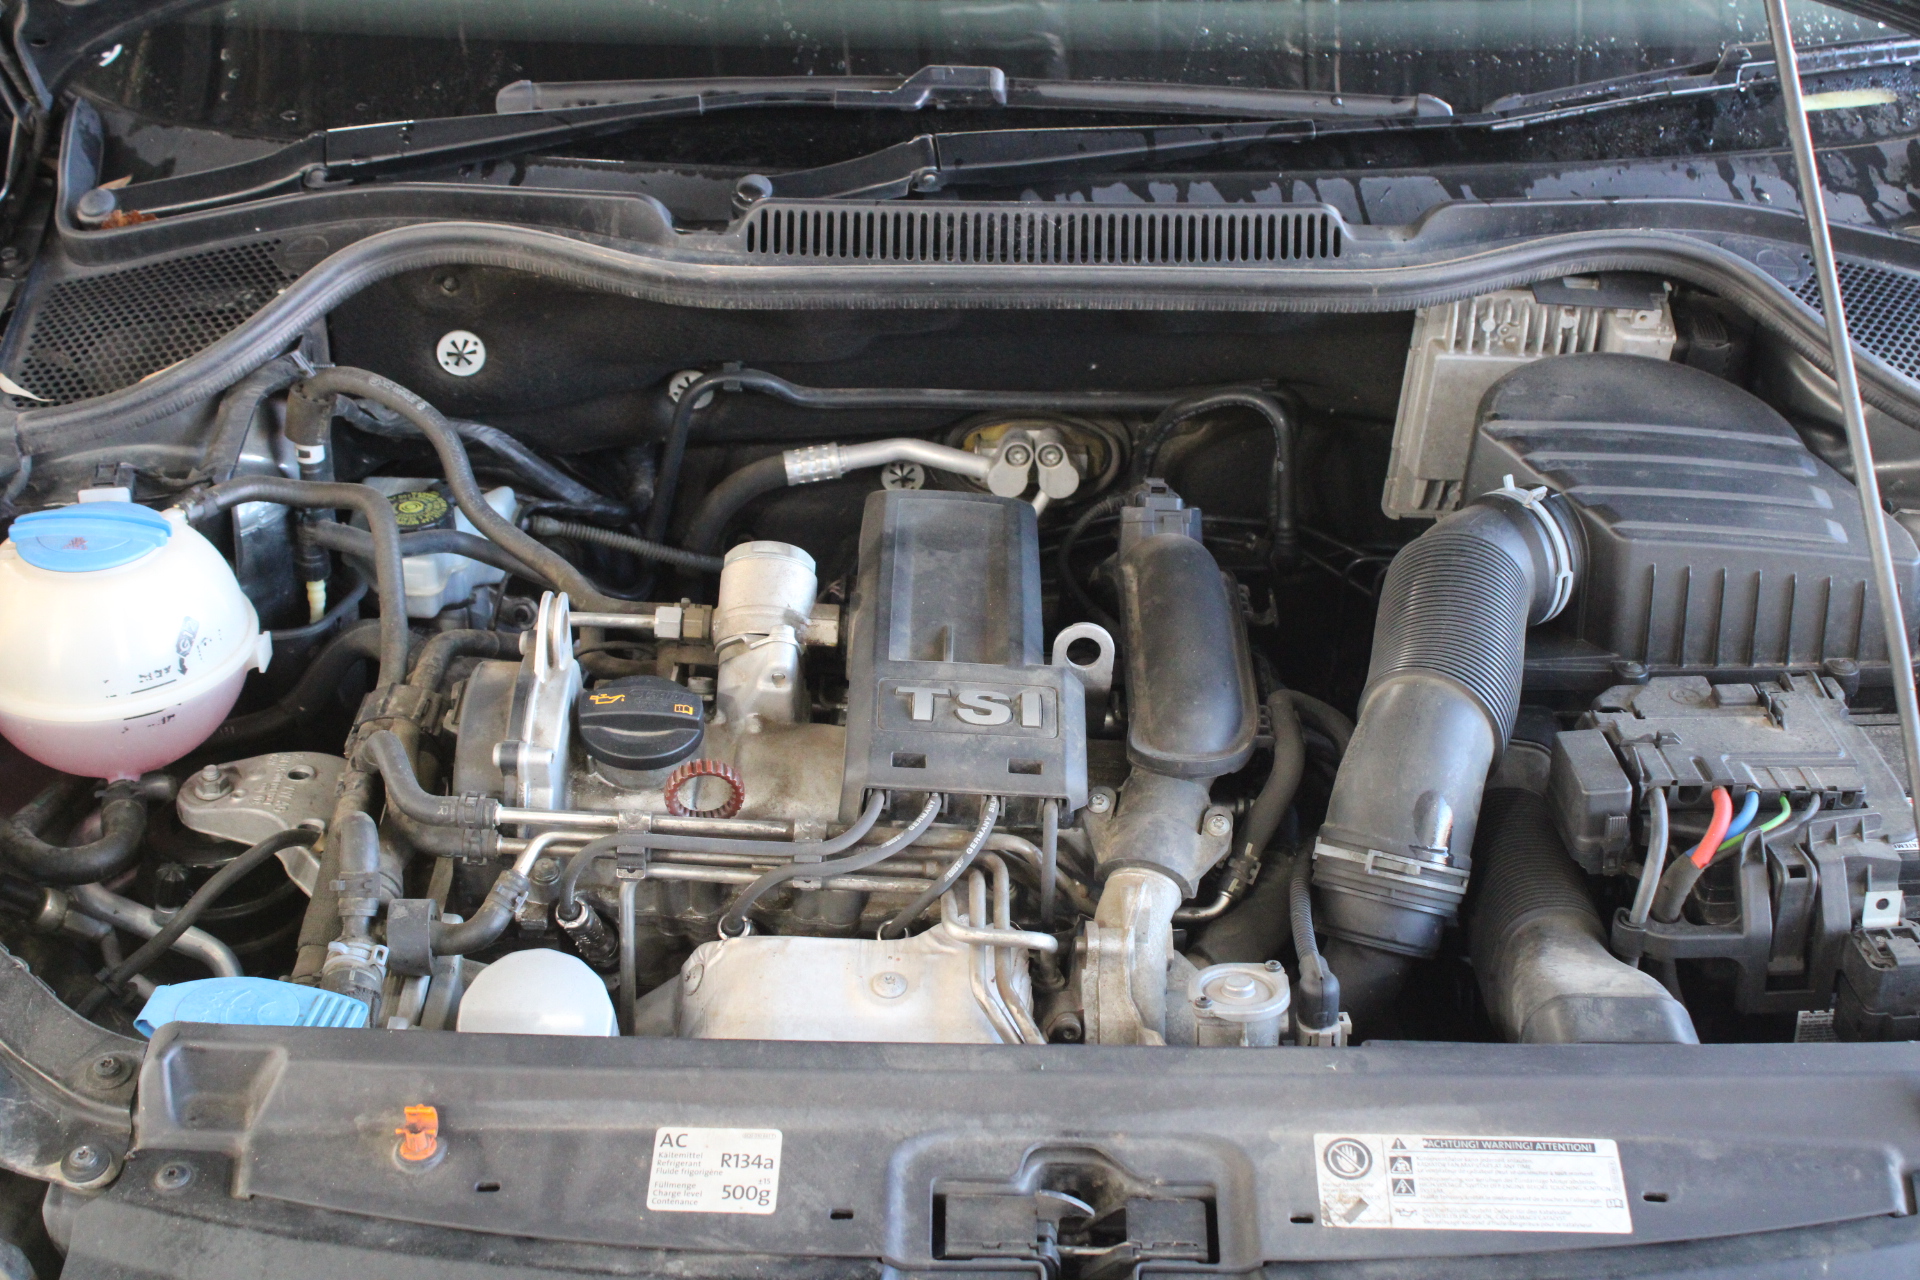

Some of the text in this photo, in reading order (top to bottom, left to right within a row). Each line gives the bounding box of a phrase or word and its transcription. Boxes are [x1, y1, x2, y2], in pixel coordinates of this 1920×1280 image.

[895, 686, 1043, 729] TSI
[908, 800, 936, 831] GERMANY
[966, 815, 992, 854] GERMANY
[660, 1133, 688, 1148] AC
[1428, 1140, 1592, 1151] ACHTUNG! WARNING! ATTENTION!
[657, 1160, 701, 1168] Refrigerant
[721, 1153, 774, 1169] R134a
[653, 1189, 681, 1198] Charge
[722, 1185, 771, 1206] 500g
[652, 1198, 698, 1206] Contenance
